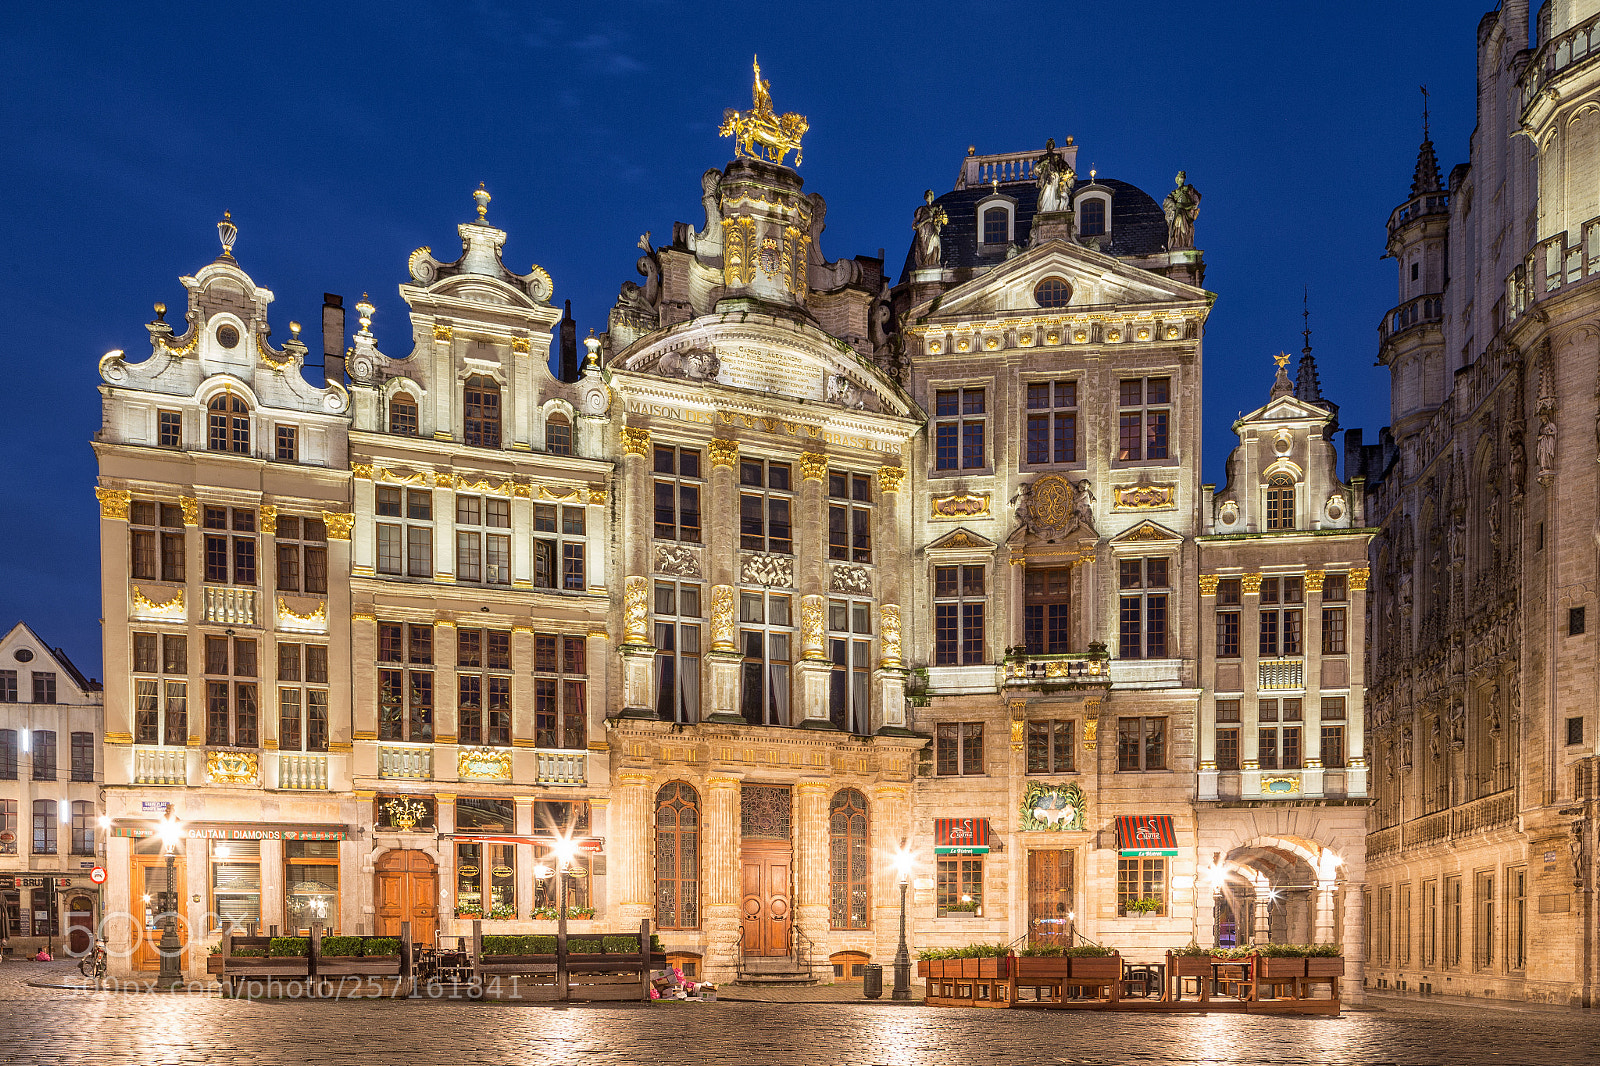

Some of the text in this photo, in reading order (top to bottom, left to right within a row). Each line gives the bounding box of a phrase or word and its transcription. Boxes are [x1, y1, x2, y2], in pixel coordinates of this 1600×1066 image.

[630, 401, 714, 424] MAISON DES
[823, 431, 900, 454] BRASSEURS
[188, 829, 226, 839] GAUTAM
[233, 830, 280, 840] DIAMONDS
